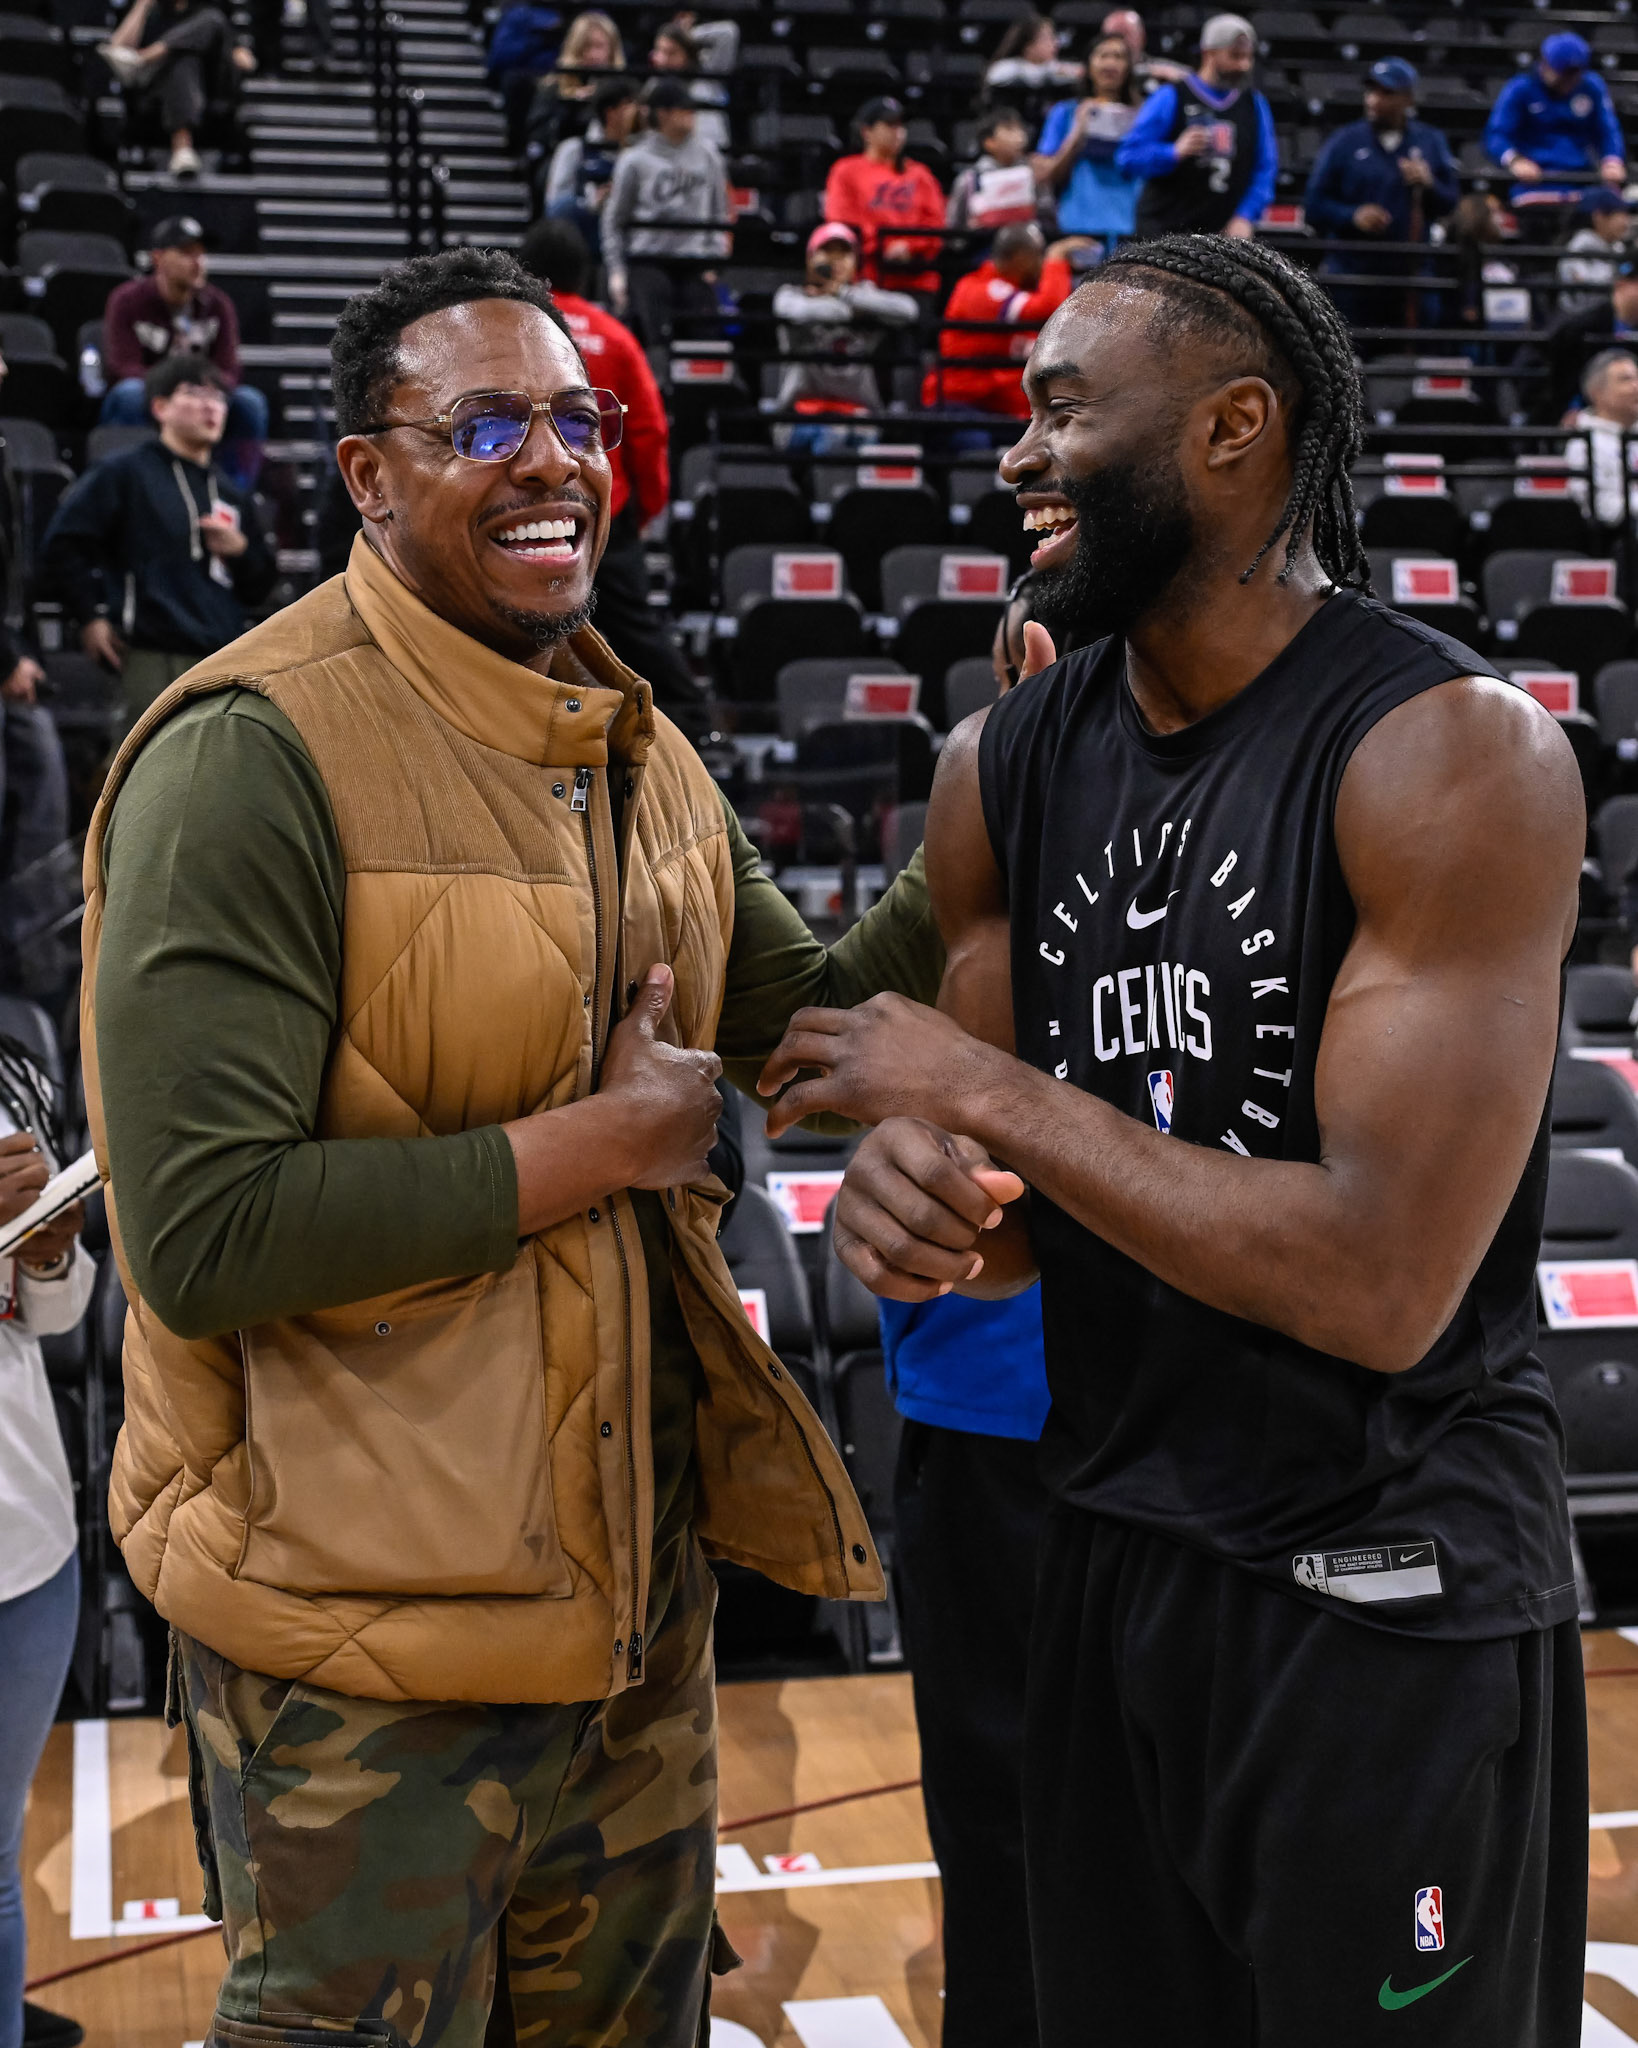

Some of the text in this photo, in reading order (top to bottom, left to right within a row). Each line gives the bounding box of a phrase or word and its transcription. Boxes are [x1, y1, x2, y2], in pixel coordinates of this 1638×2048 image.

[1209, 849, 1295, 1158] BASKETBA
[1332, 1553, 1382, 1564] ENGINEERED
[1419, 1935, 1434, 1948] NBA
